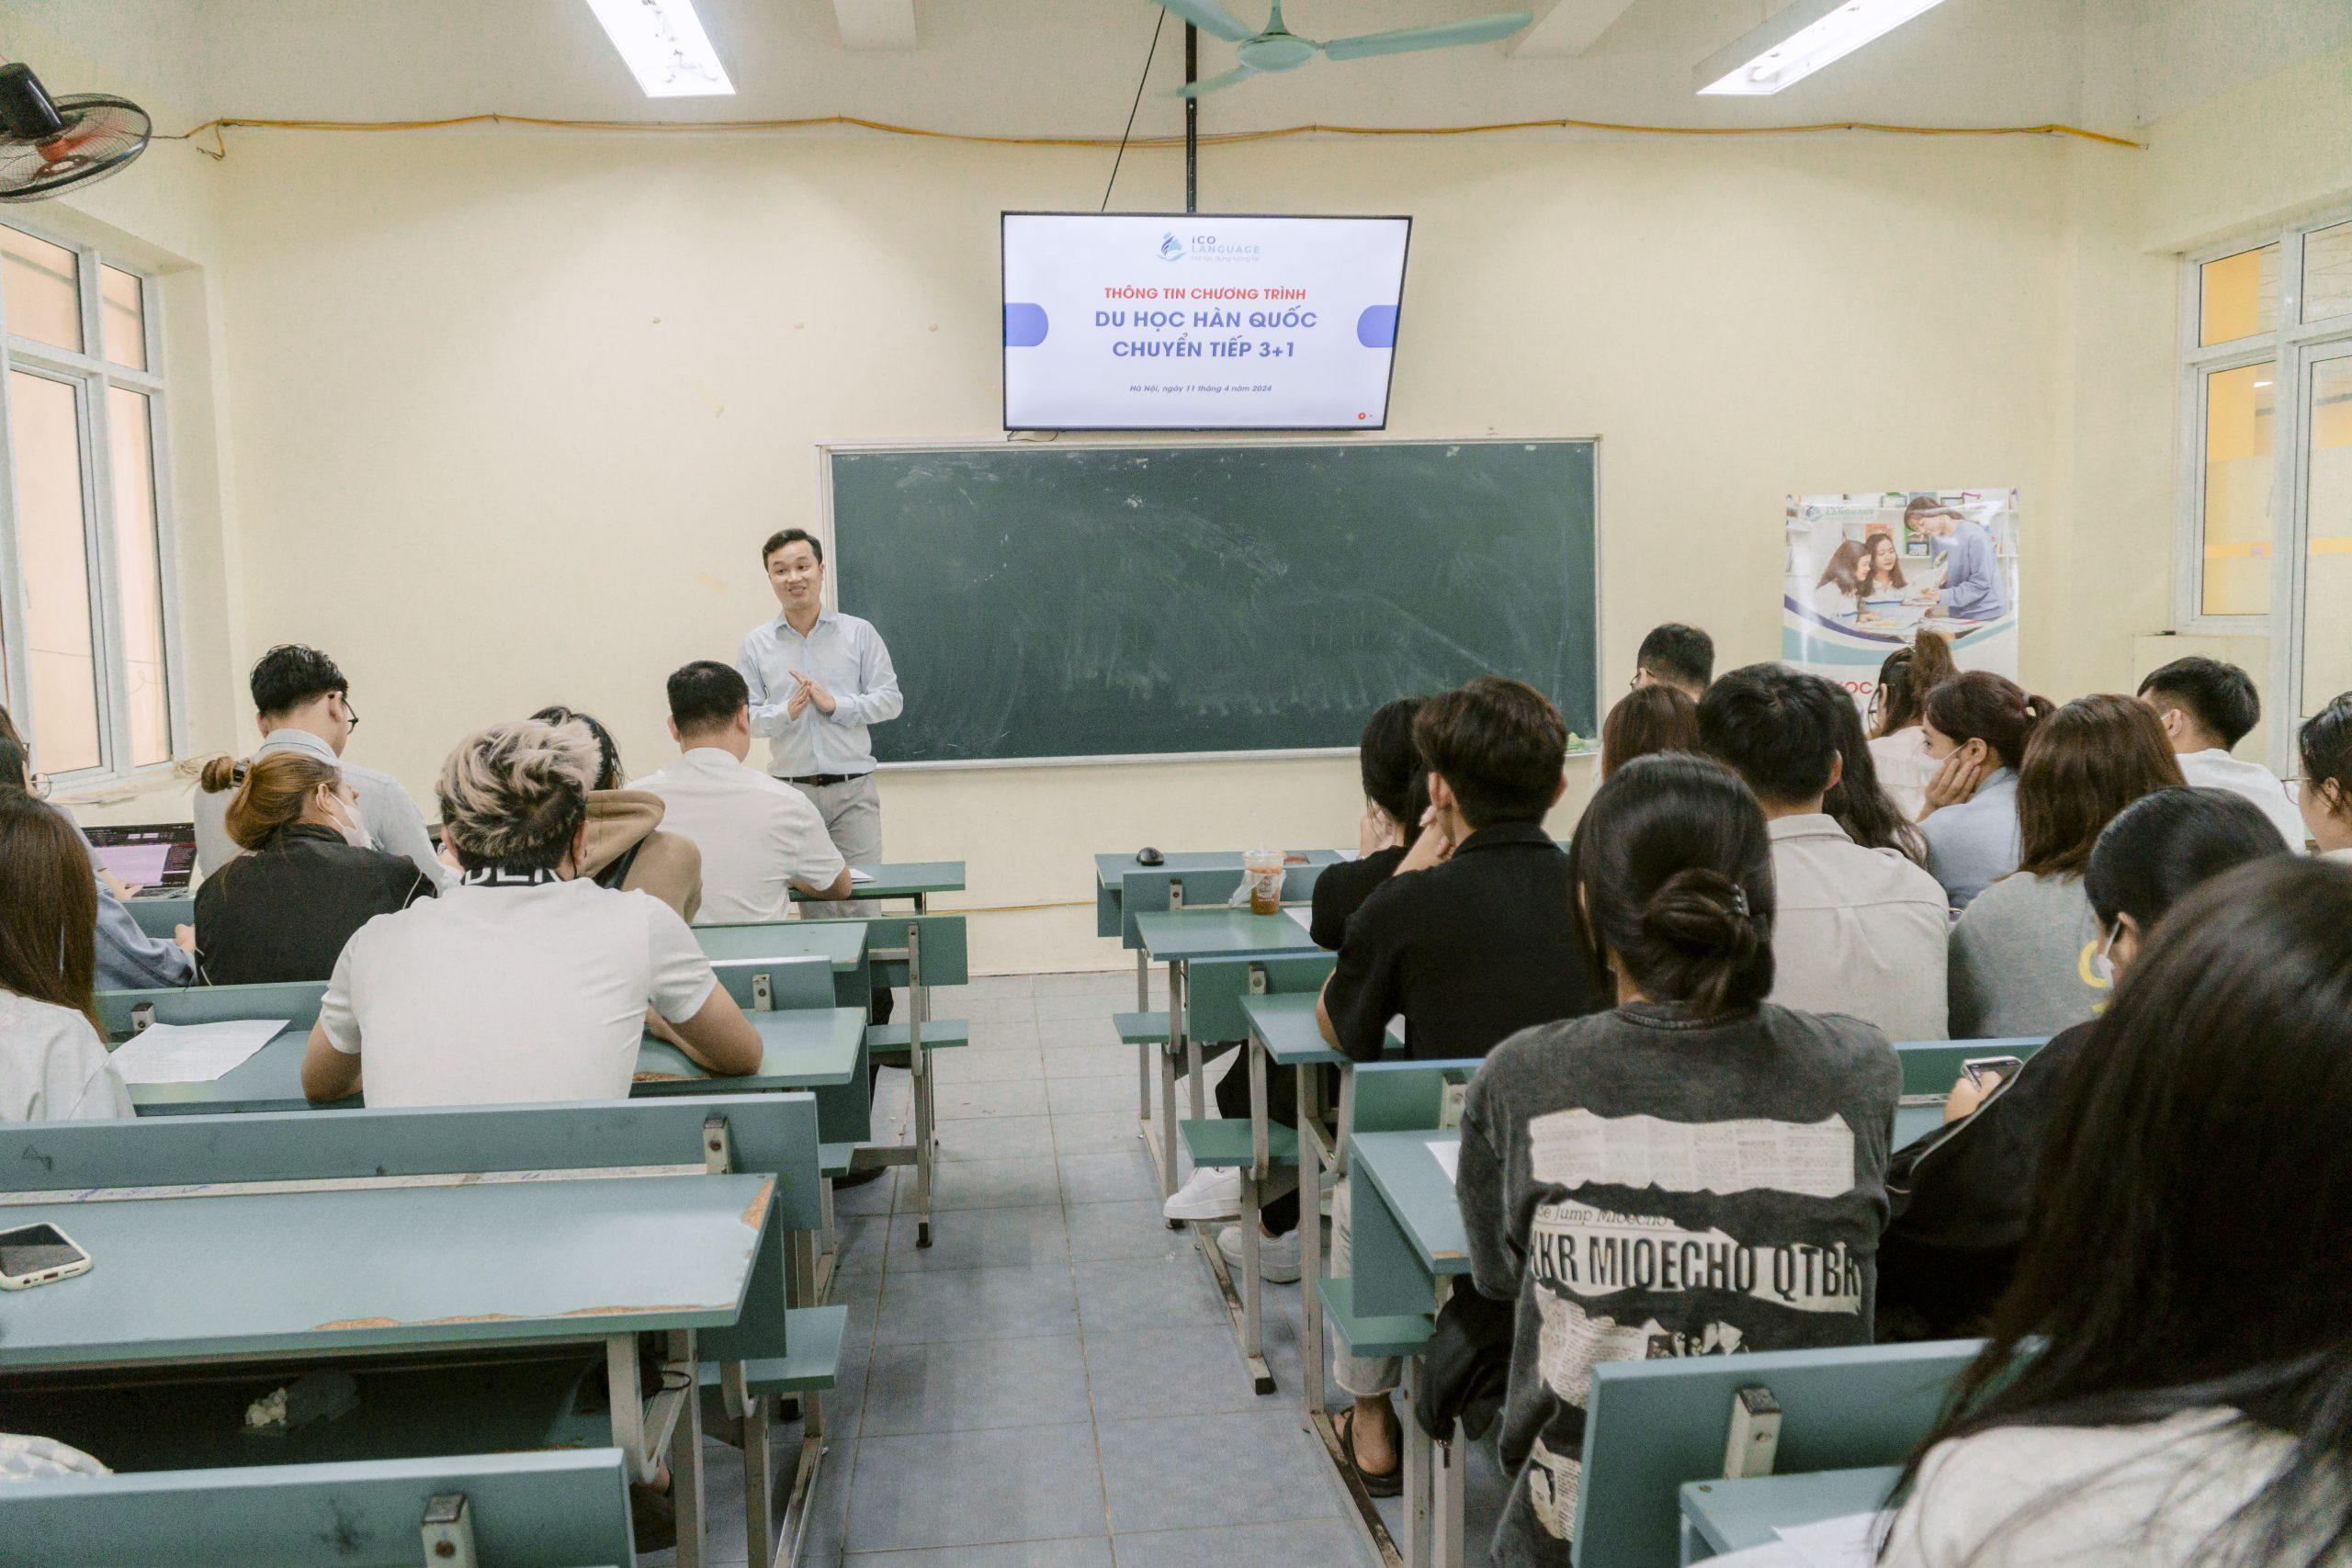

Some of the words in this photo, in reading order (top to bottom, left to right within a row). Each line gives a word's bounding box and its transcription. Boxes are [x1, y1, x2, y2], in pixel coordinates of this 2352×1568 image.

[1192, 235, 1216, 244] ICO
[1192, 245, 1261, 254] LANGUAGE
[1104, 284, 1159, 299] THÔNG
[1163, 288, 1186, 299] TIN
[1191, 286, 1259, 299] CHƯƠNG
[1264, 285, 1306, 300] TRÌNH
[1095, 310, 1125, 327] DU
[1134, 310, 1185, 332] HỌC
[1193, 307, 1241, 328] HÀN
[1249, 304, 1317, 328] QUỐC
[1113, 332, 1203, 357] CHUYỂN
[1209, 334, 1252, 357] TIẾP
[1259, 341, 1295, 357] 3+1
[1589, 1235, 1758, 1292] MIOECHO
